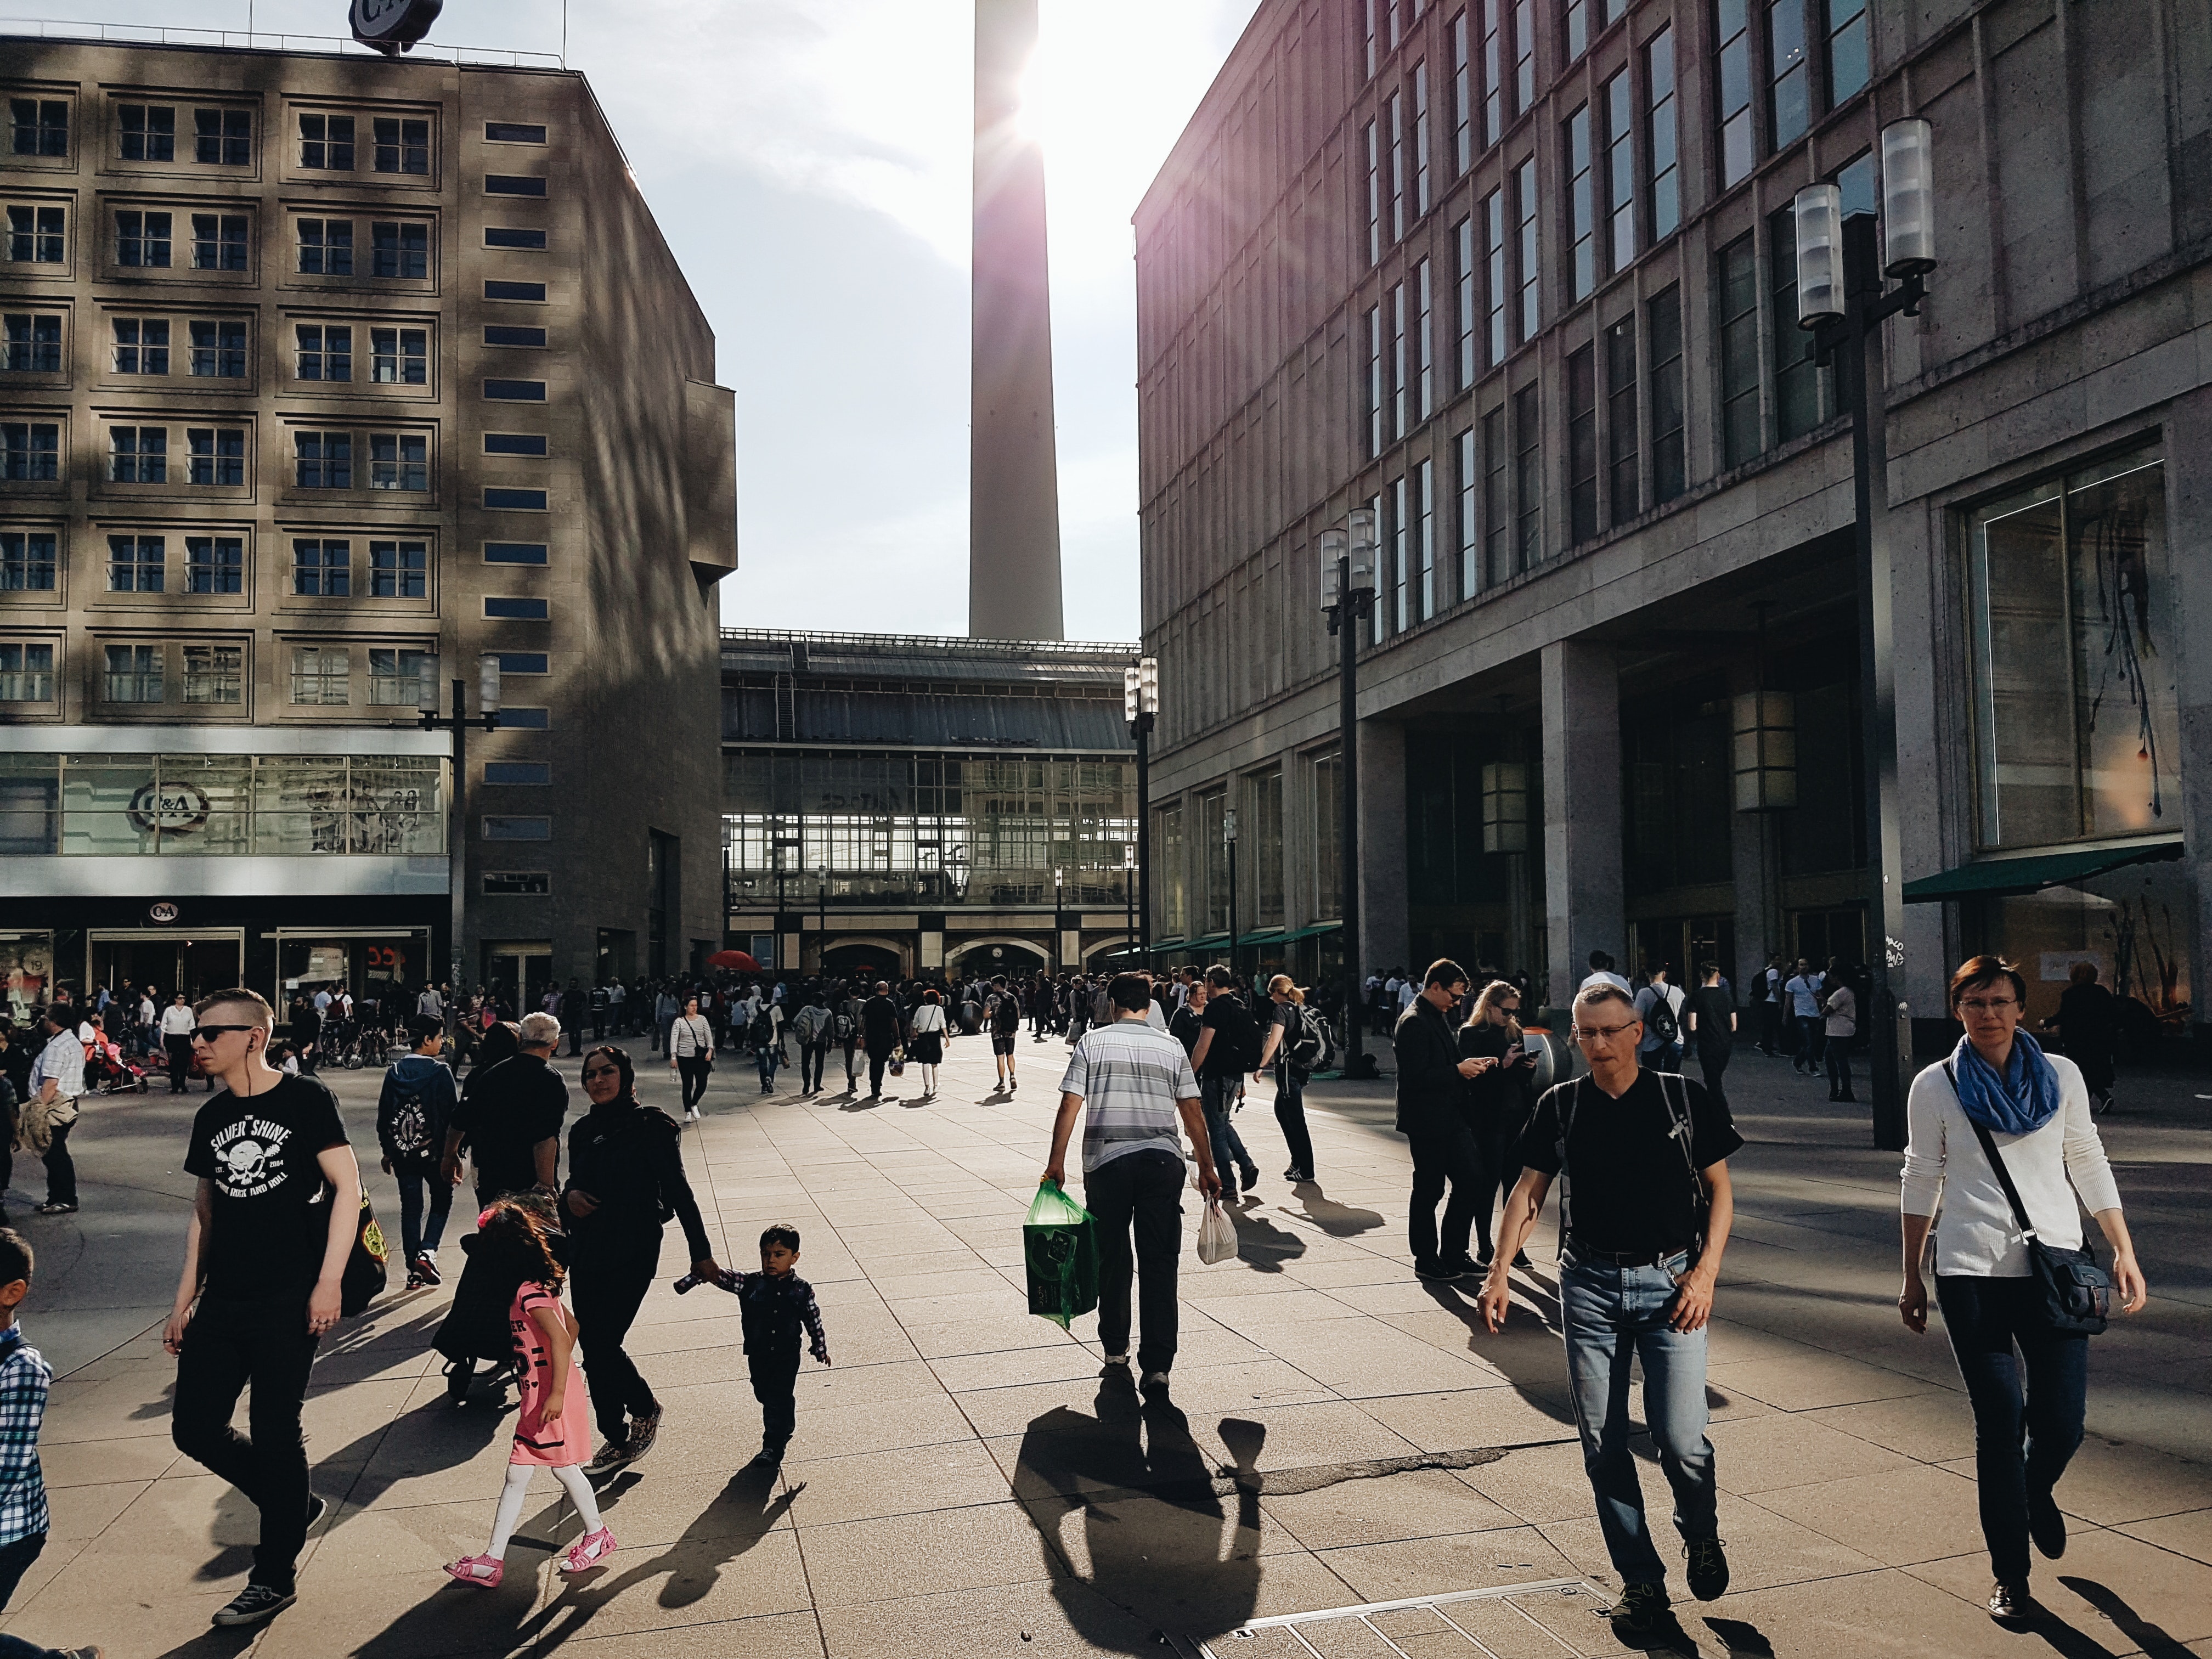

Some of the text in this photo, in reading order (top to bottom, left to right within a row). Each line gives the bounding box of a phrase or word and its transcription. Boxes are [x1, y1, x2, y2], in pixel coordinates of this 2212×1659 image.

[144, 794, 194, 818] C&A
[153, 906, 174, 917] C&A
[211, 1119, 292, 1152] SILVER SHINE
[269, 1159, 284, 1168] 2004
[230, 1188, 247, 1198] ROCK
[250, 1183, 268, 1196] AND
[268, 1172, 289, 1189] ROLL
